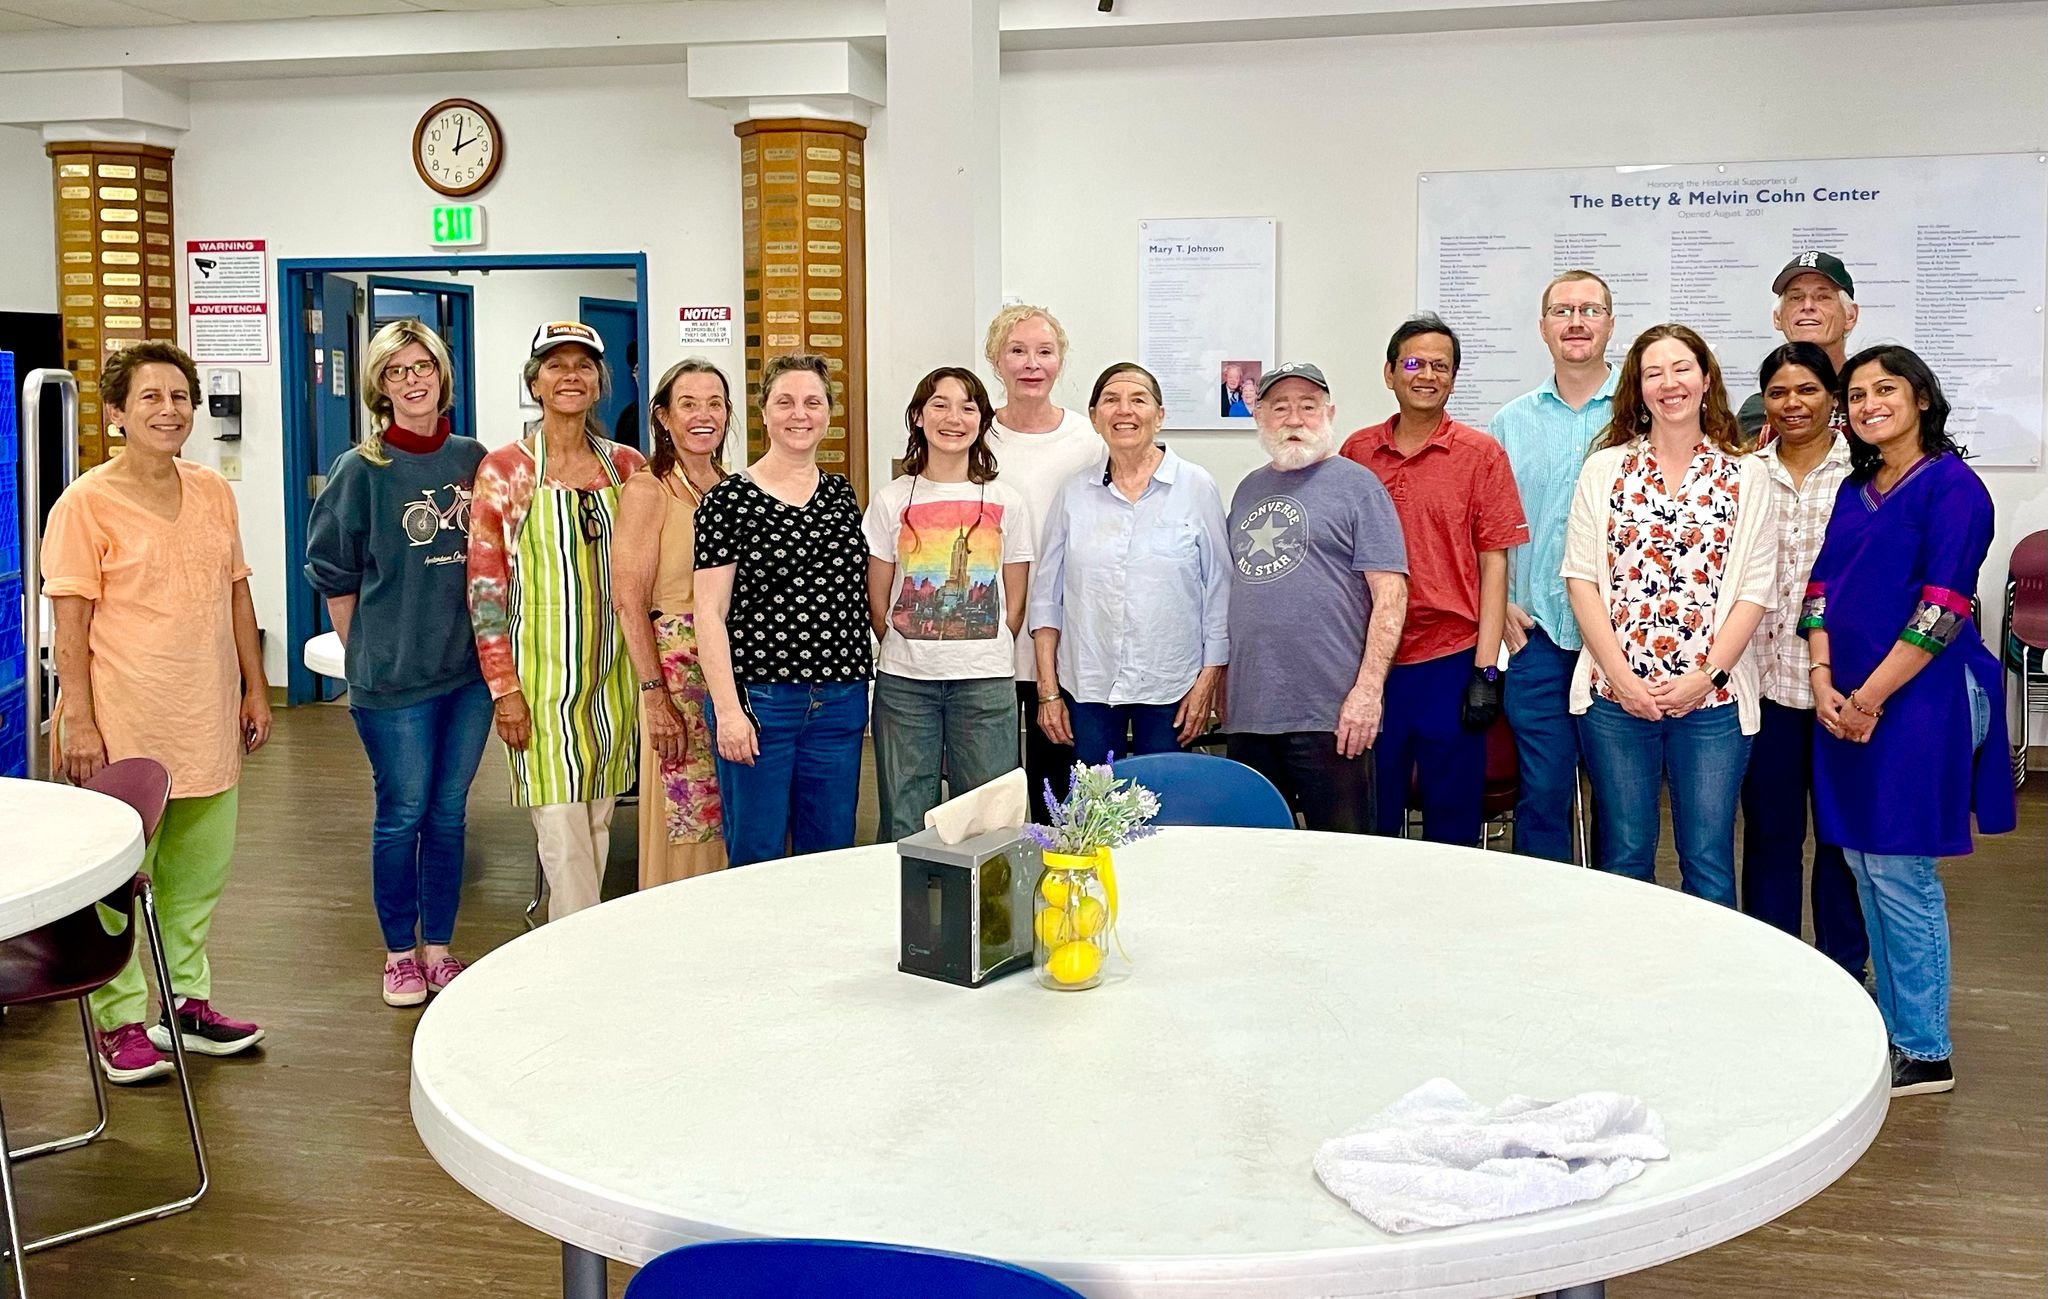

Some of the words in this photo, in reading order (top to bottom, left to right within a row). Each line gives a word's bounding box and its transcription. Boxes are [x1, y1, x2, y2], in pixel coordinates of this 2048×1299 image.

[440, 118, 449, 130] 11
[452, 113, 463, 126] 12
[467, 116, 472, 127] 1
[431, 130, 441, 142] 10
[476, 126, 484, 138] 2
[427, 144, 435, 156] 9
[481, 141, 489, 153] 3
[432, 160, 440, 171] 8
[477, 157, 484, 168] 4
[443, 168, 450, 179] 7
[455, 171, 463, 183] 6
[467, 168, 475, 179] 5
[1647, 181, 1685, 190] Honoring
[1686, 180, 1700, 188] the
[1702, 178, 1739, 187] Historical
[1742, 177, 1787, 187] Supporters
[1789, 176, 1798, 184] of
[1569, 194, 1604, 209] The
[1611, 193, 1661, 210] Betty
[1668, 191, 1681, 206] &
[1689, 190, 1749, 206] Melvin
[1756, 189, 1805, 203] Cohn
[1813, 187, 1880, 202] Center
[1678, 211, 1711, 219] Opened
[1745, 209, 1764, 217] 2001
[433, 207, 473, 242] EXIT
[199, 241, 255, 251] WARNING
[1149, 245, 1173, 255] Mary
[1176, 244, 1185, 253] T.
[1187, 244, 1225, 254] Johnson
[194, 304, 262, 314] ADVERTENCIA
[683, 308, 727, 320] NOTICE
[1240, 501, 1300, 530] CONVERSE
[1237, 556, 1252, 576] ALL
[1255, 554, 1292, 576] STAR
